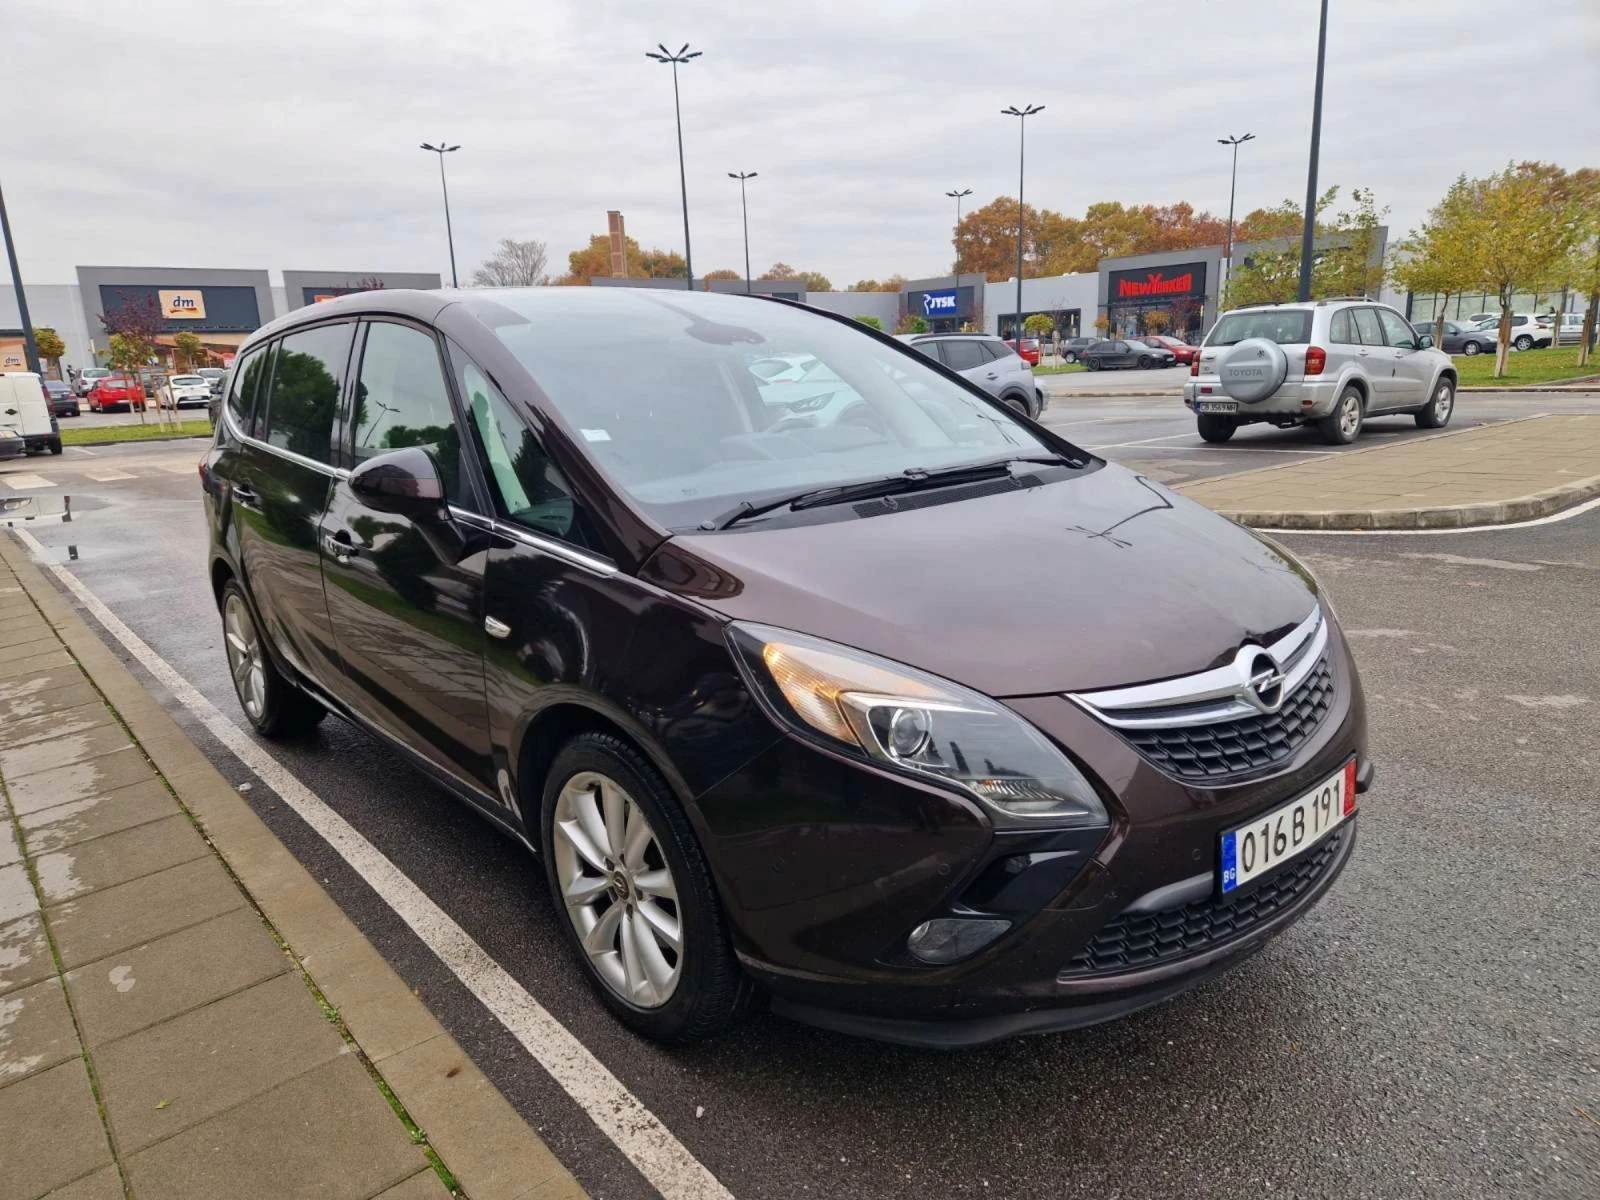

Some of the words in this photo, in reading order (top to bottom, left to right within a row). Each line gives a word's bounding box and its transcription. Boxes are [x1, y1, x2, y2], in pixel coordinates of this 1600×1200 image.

[173, 296, 194, 307] dm
[930, 295, 956, 309] JYSK
[1229, 369, 1264, 377] TOYOTA
[1223, 868, 1236, 883] BG
